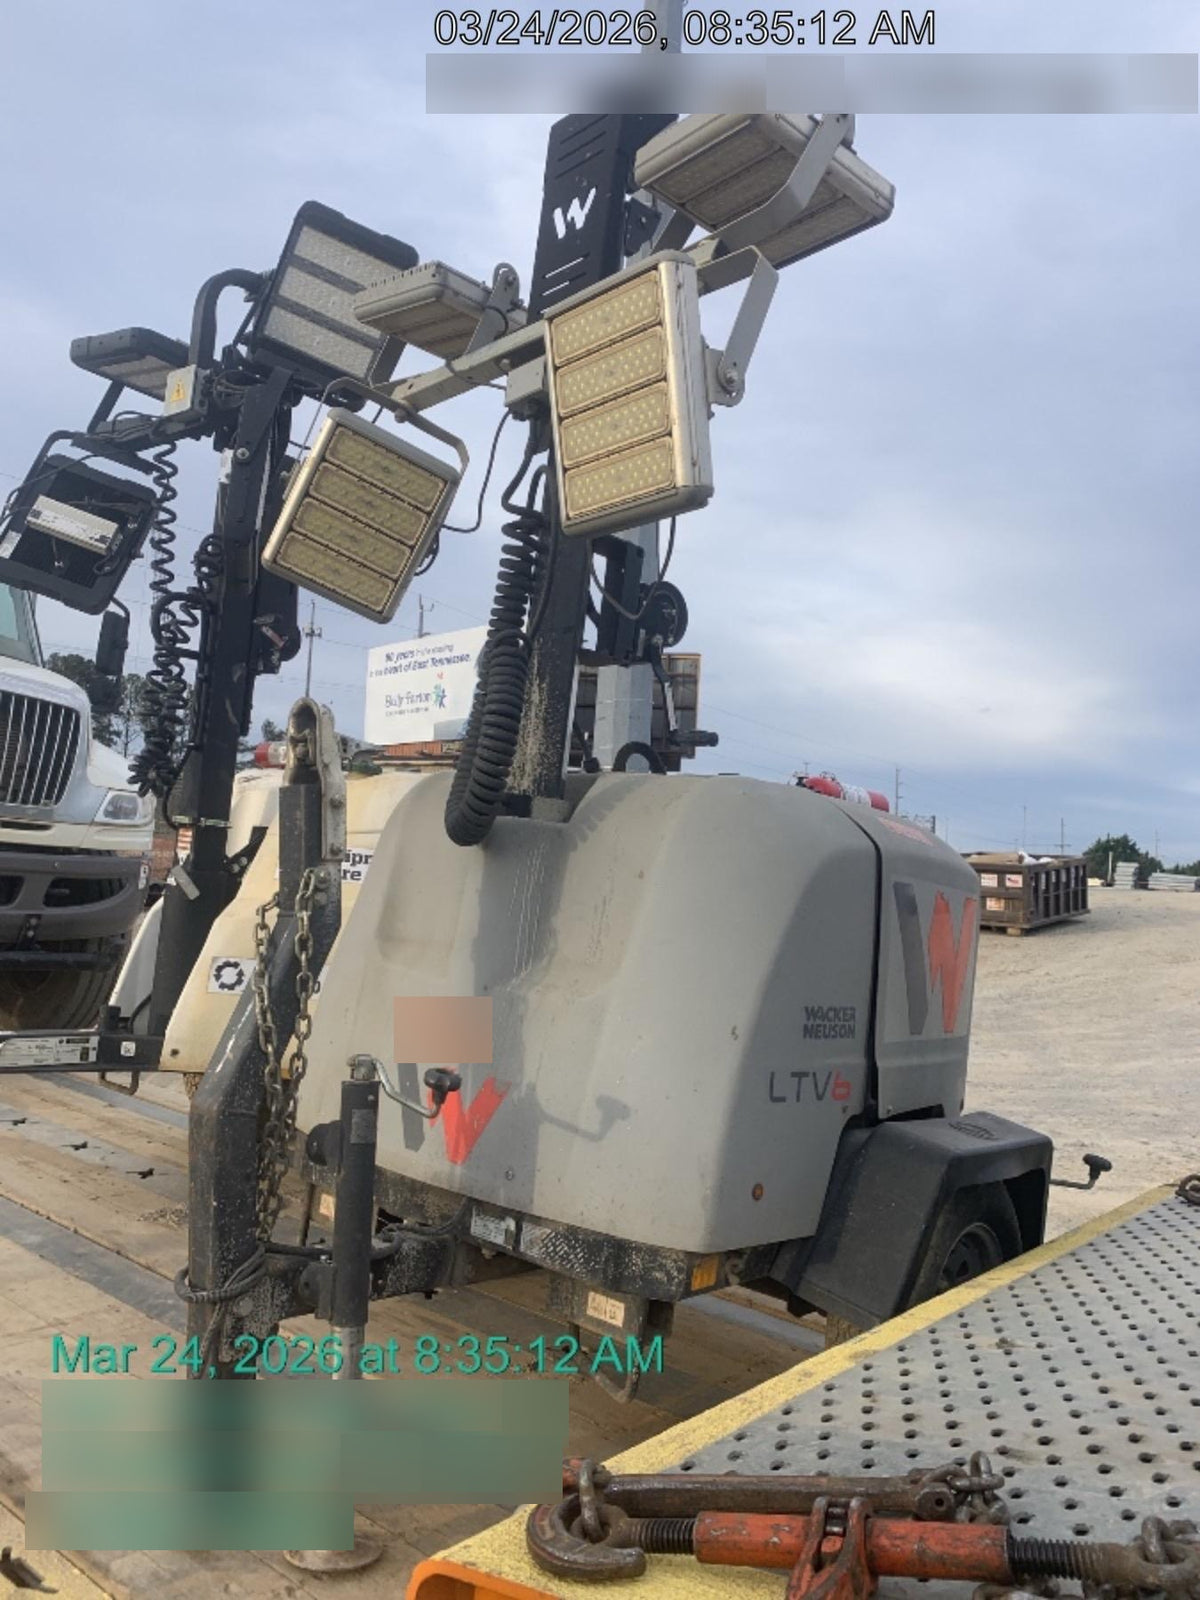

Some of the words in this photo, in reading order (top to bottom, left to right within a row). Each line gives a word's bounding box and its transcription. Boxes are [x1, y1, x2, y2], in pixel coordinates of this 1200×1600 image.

[804, 1006, 856, 1022] WACKER
[803, 1024, 856, 1040] NEUSON
[769, 1068, 852, 1103] LTV6
